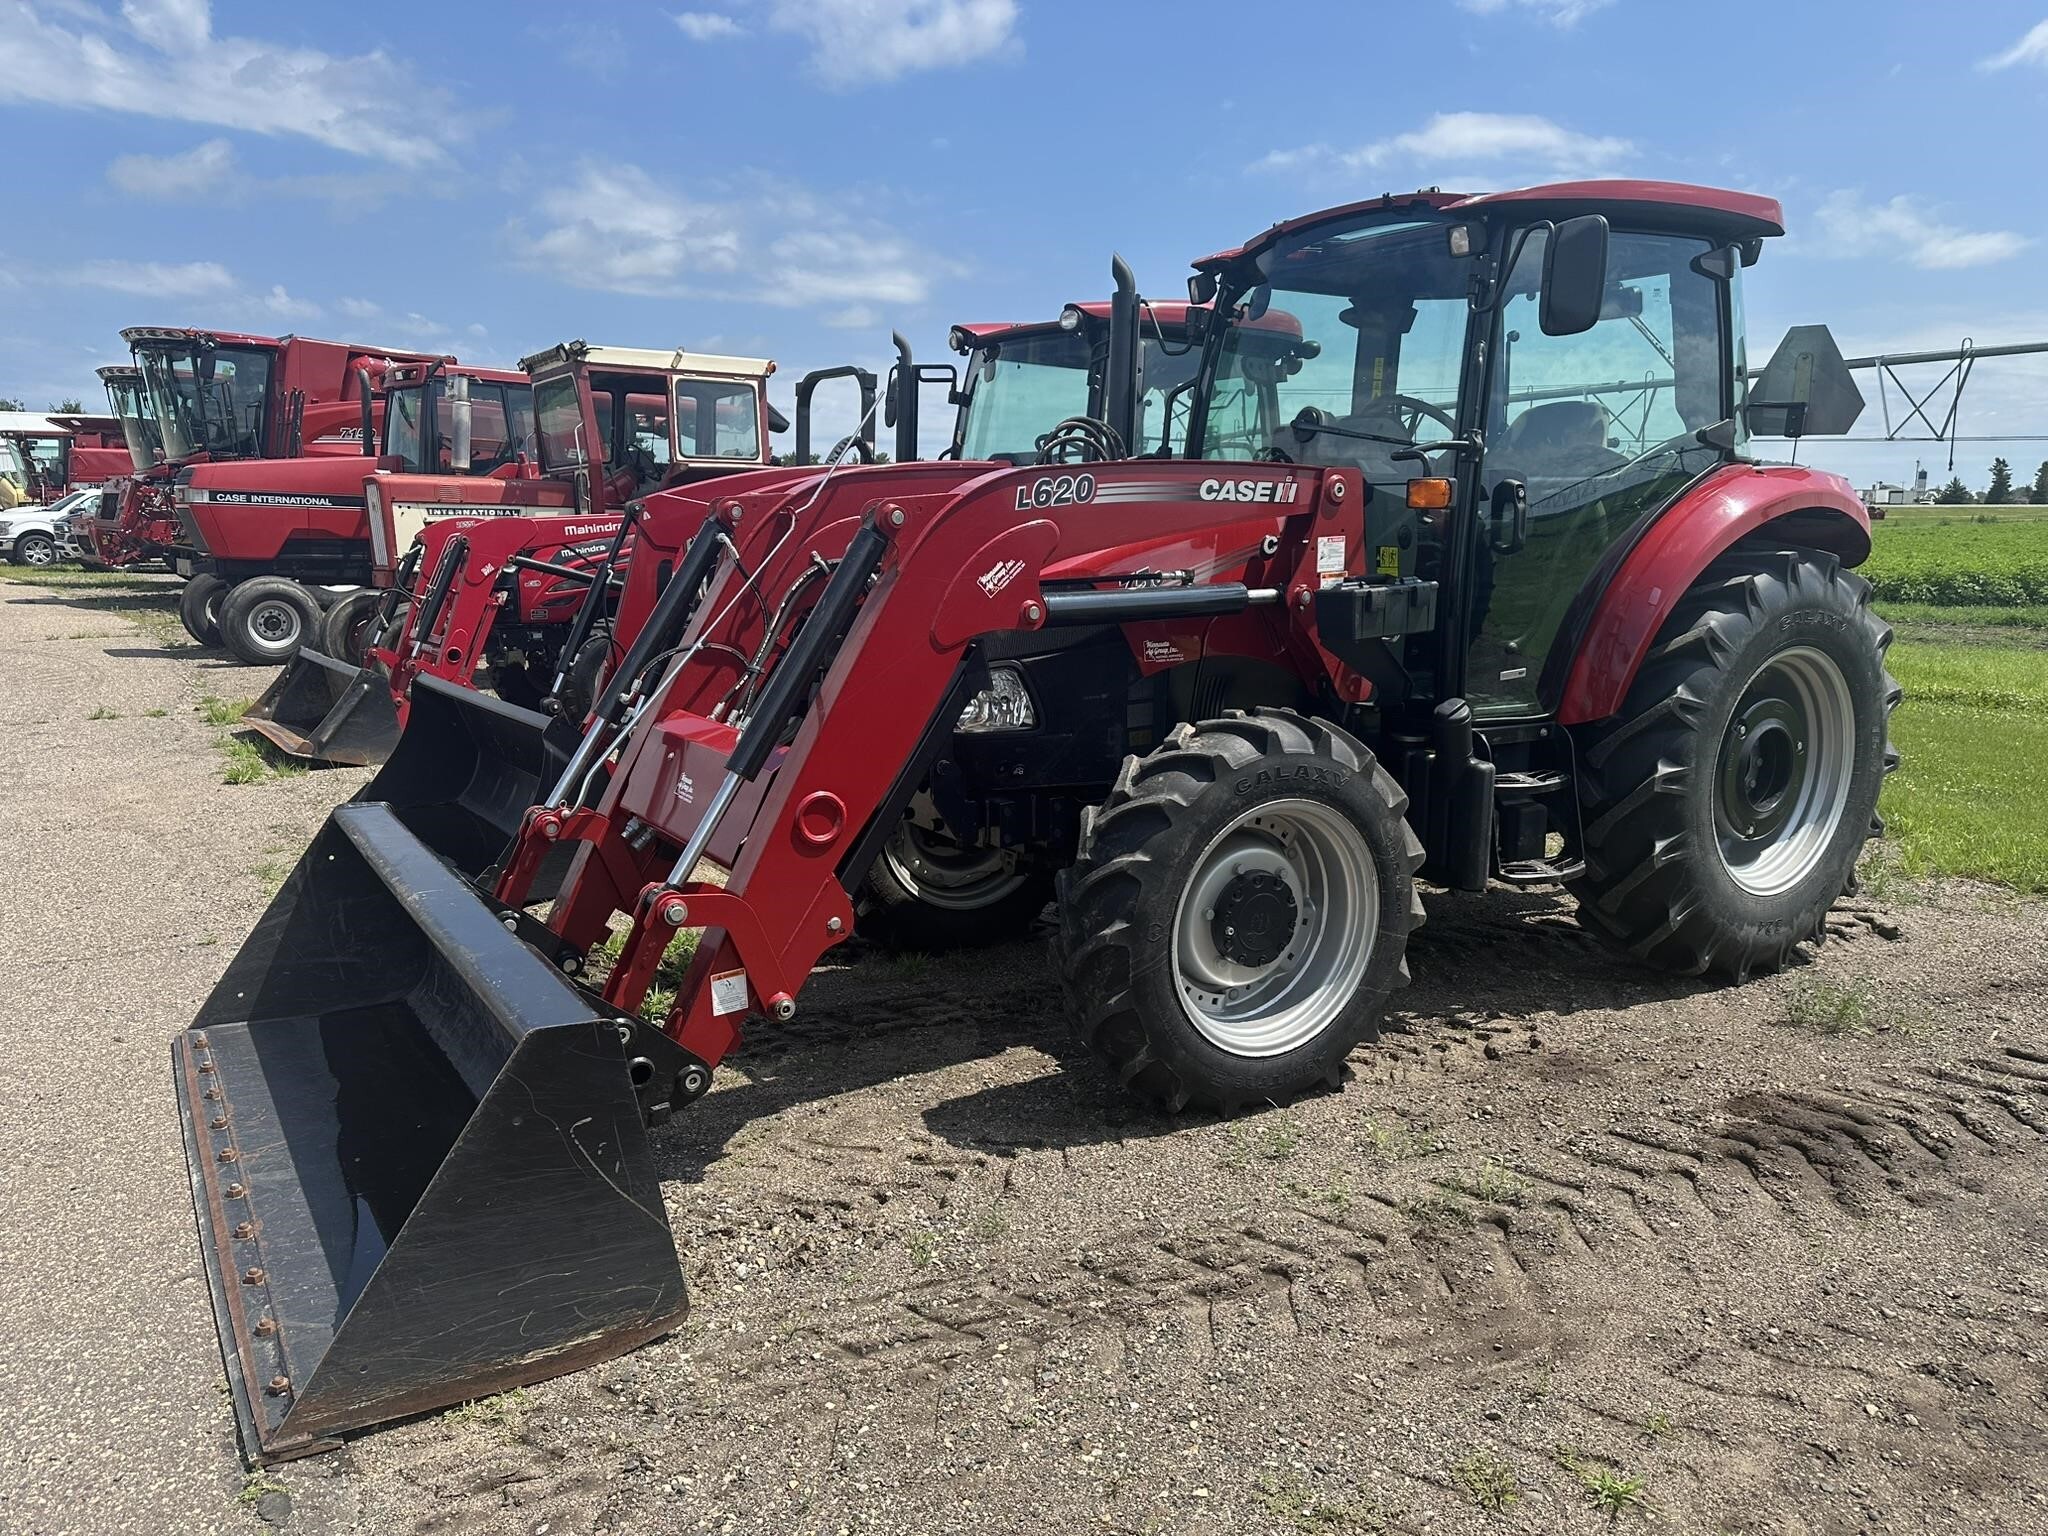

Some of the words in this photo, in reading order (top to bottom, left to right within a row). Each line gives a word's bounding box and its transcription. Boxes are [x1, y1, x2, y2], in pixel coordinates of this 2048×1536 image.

[216, 493, 247, 502] CASE
[251, 495, 332, 506] INTERNATIONAL
[1015, 473, 1095, 510] L620
[1199, 478, 1273, 502] CASE
[429, 508, 519, 516] INTERNATIONAL
[1233, 764, 1350, 796] GALAXY
